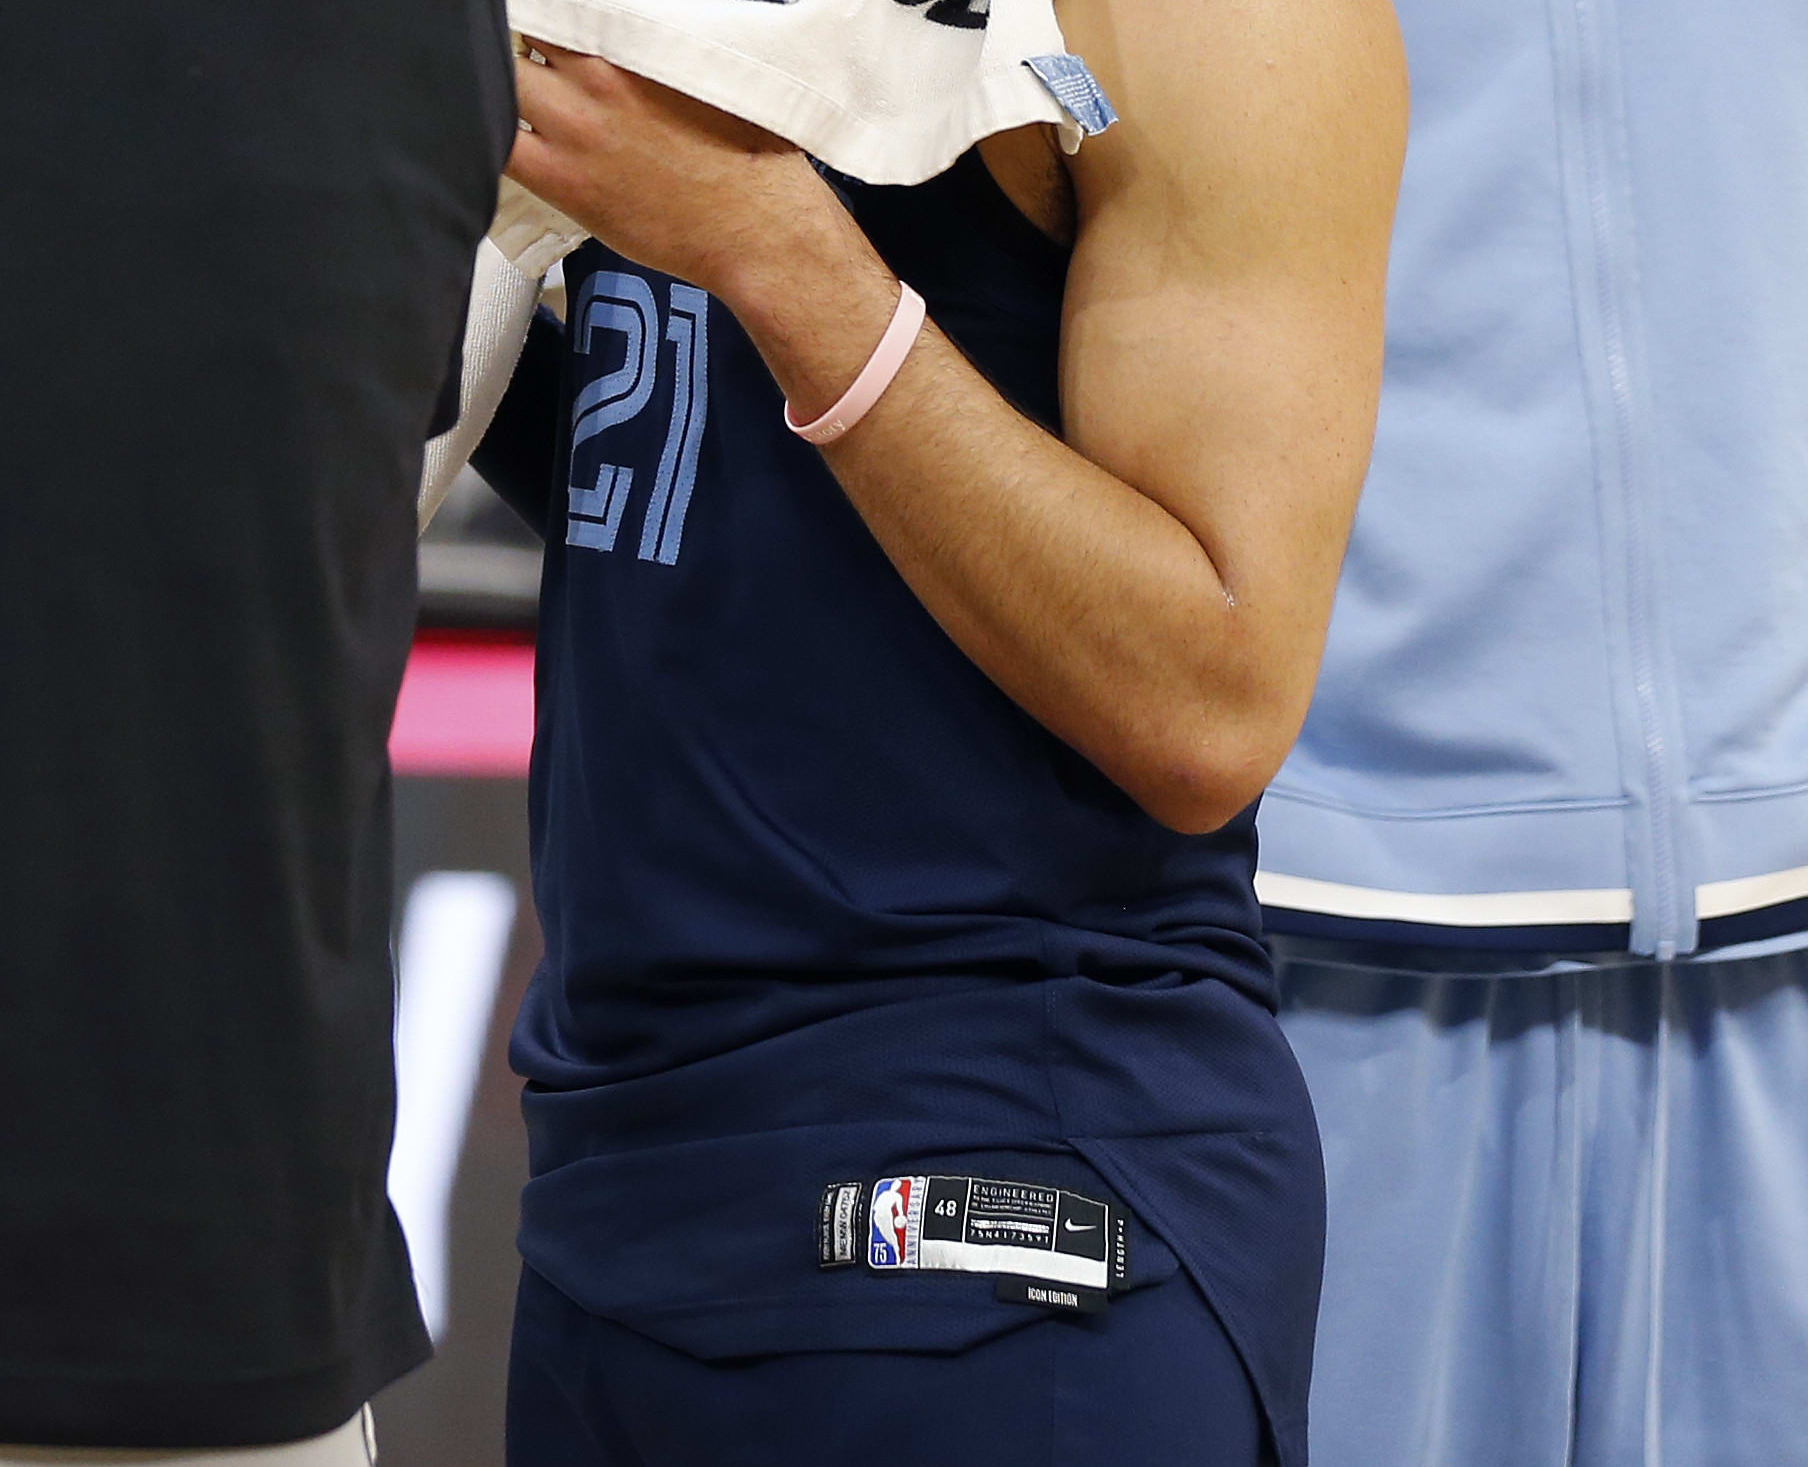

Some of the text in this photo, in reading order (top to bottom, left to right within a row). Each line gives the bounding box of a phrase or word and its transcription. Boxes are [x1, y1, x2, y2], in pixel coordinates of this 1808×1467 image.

[566, 270, 709, 566] 21
[973, 1184, 1054, 1202] ENGINEERED
[934, 1199, 957, 1217] 48
[873, 1242, 888, 1264] 75
[1027, 1286, 1078, 1307] ICON EDITION
